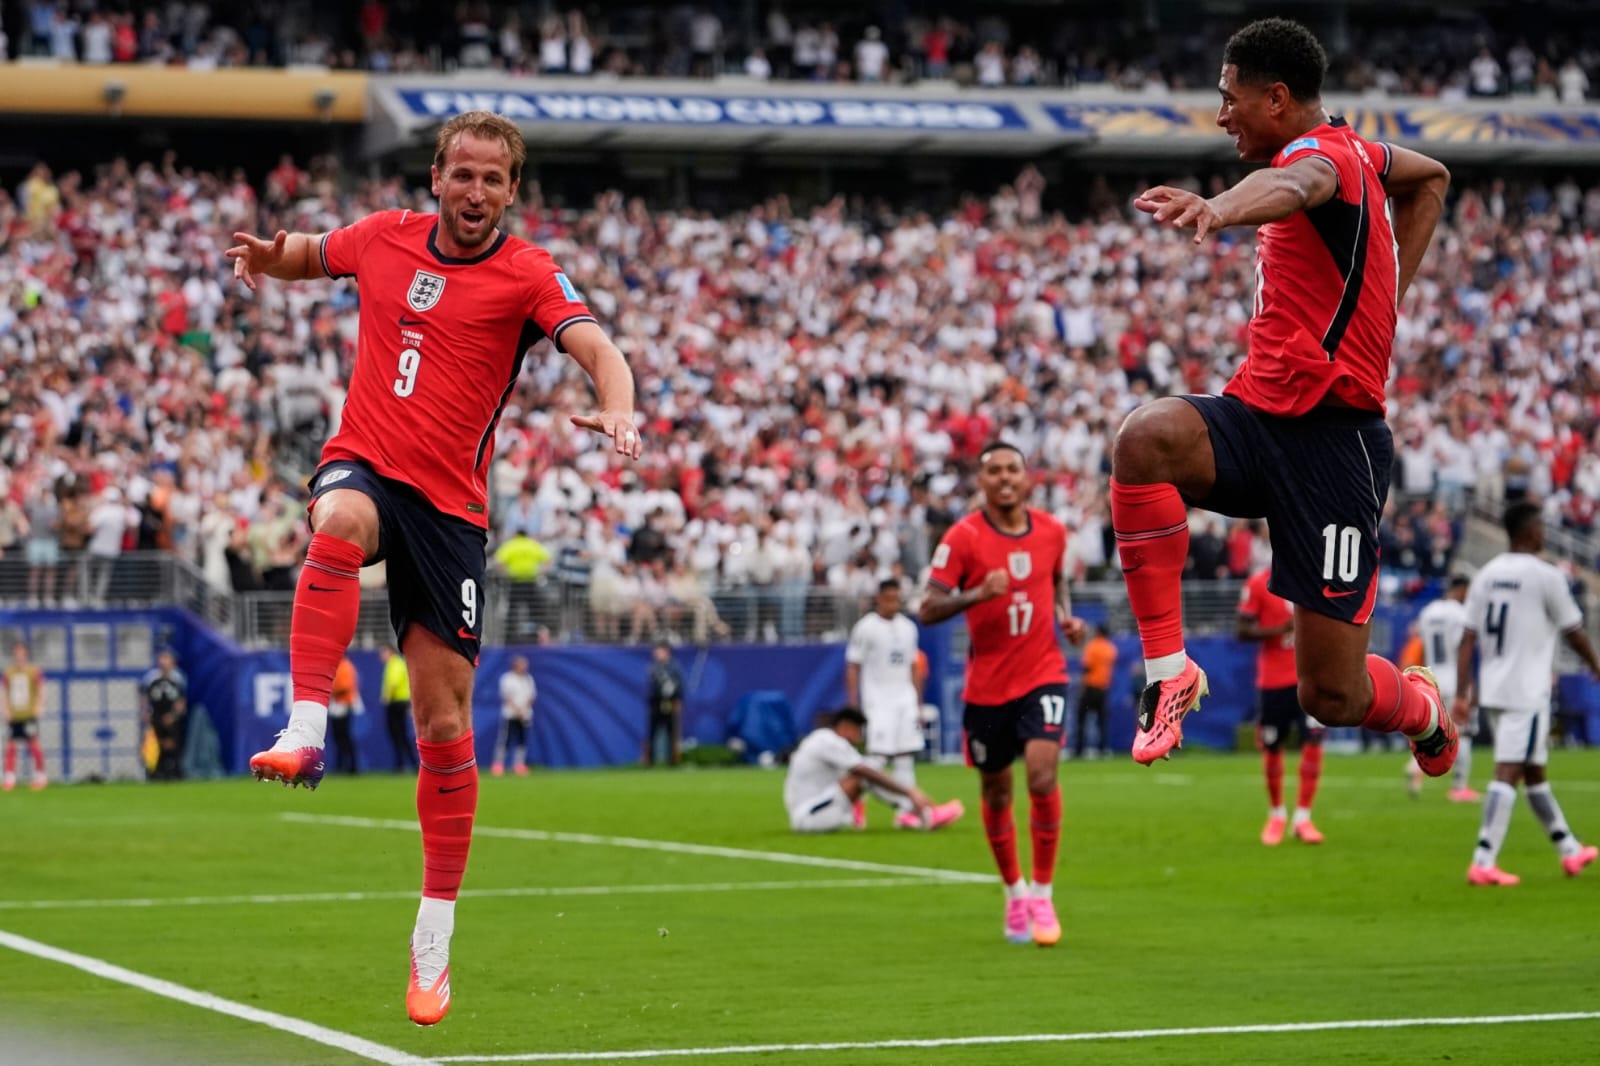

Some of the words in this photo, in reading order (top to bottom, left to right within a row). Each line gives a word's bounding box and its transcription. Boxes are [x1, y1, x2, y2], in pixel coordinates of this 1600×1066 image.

[537, 95, 723, 123] WORLD
[725, 98, 825, 126] CUP
[393, 348, 421, 398] 9
[1322, 523, 1362, 582] 10
[461, 578, 477, 629] 9
[1008, 601, 1033, 636] 17
[1485, 602, 1509, 656] 4
[1040, 694, 1065, 725] 17
